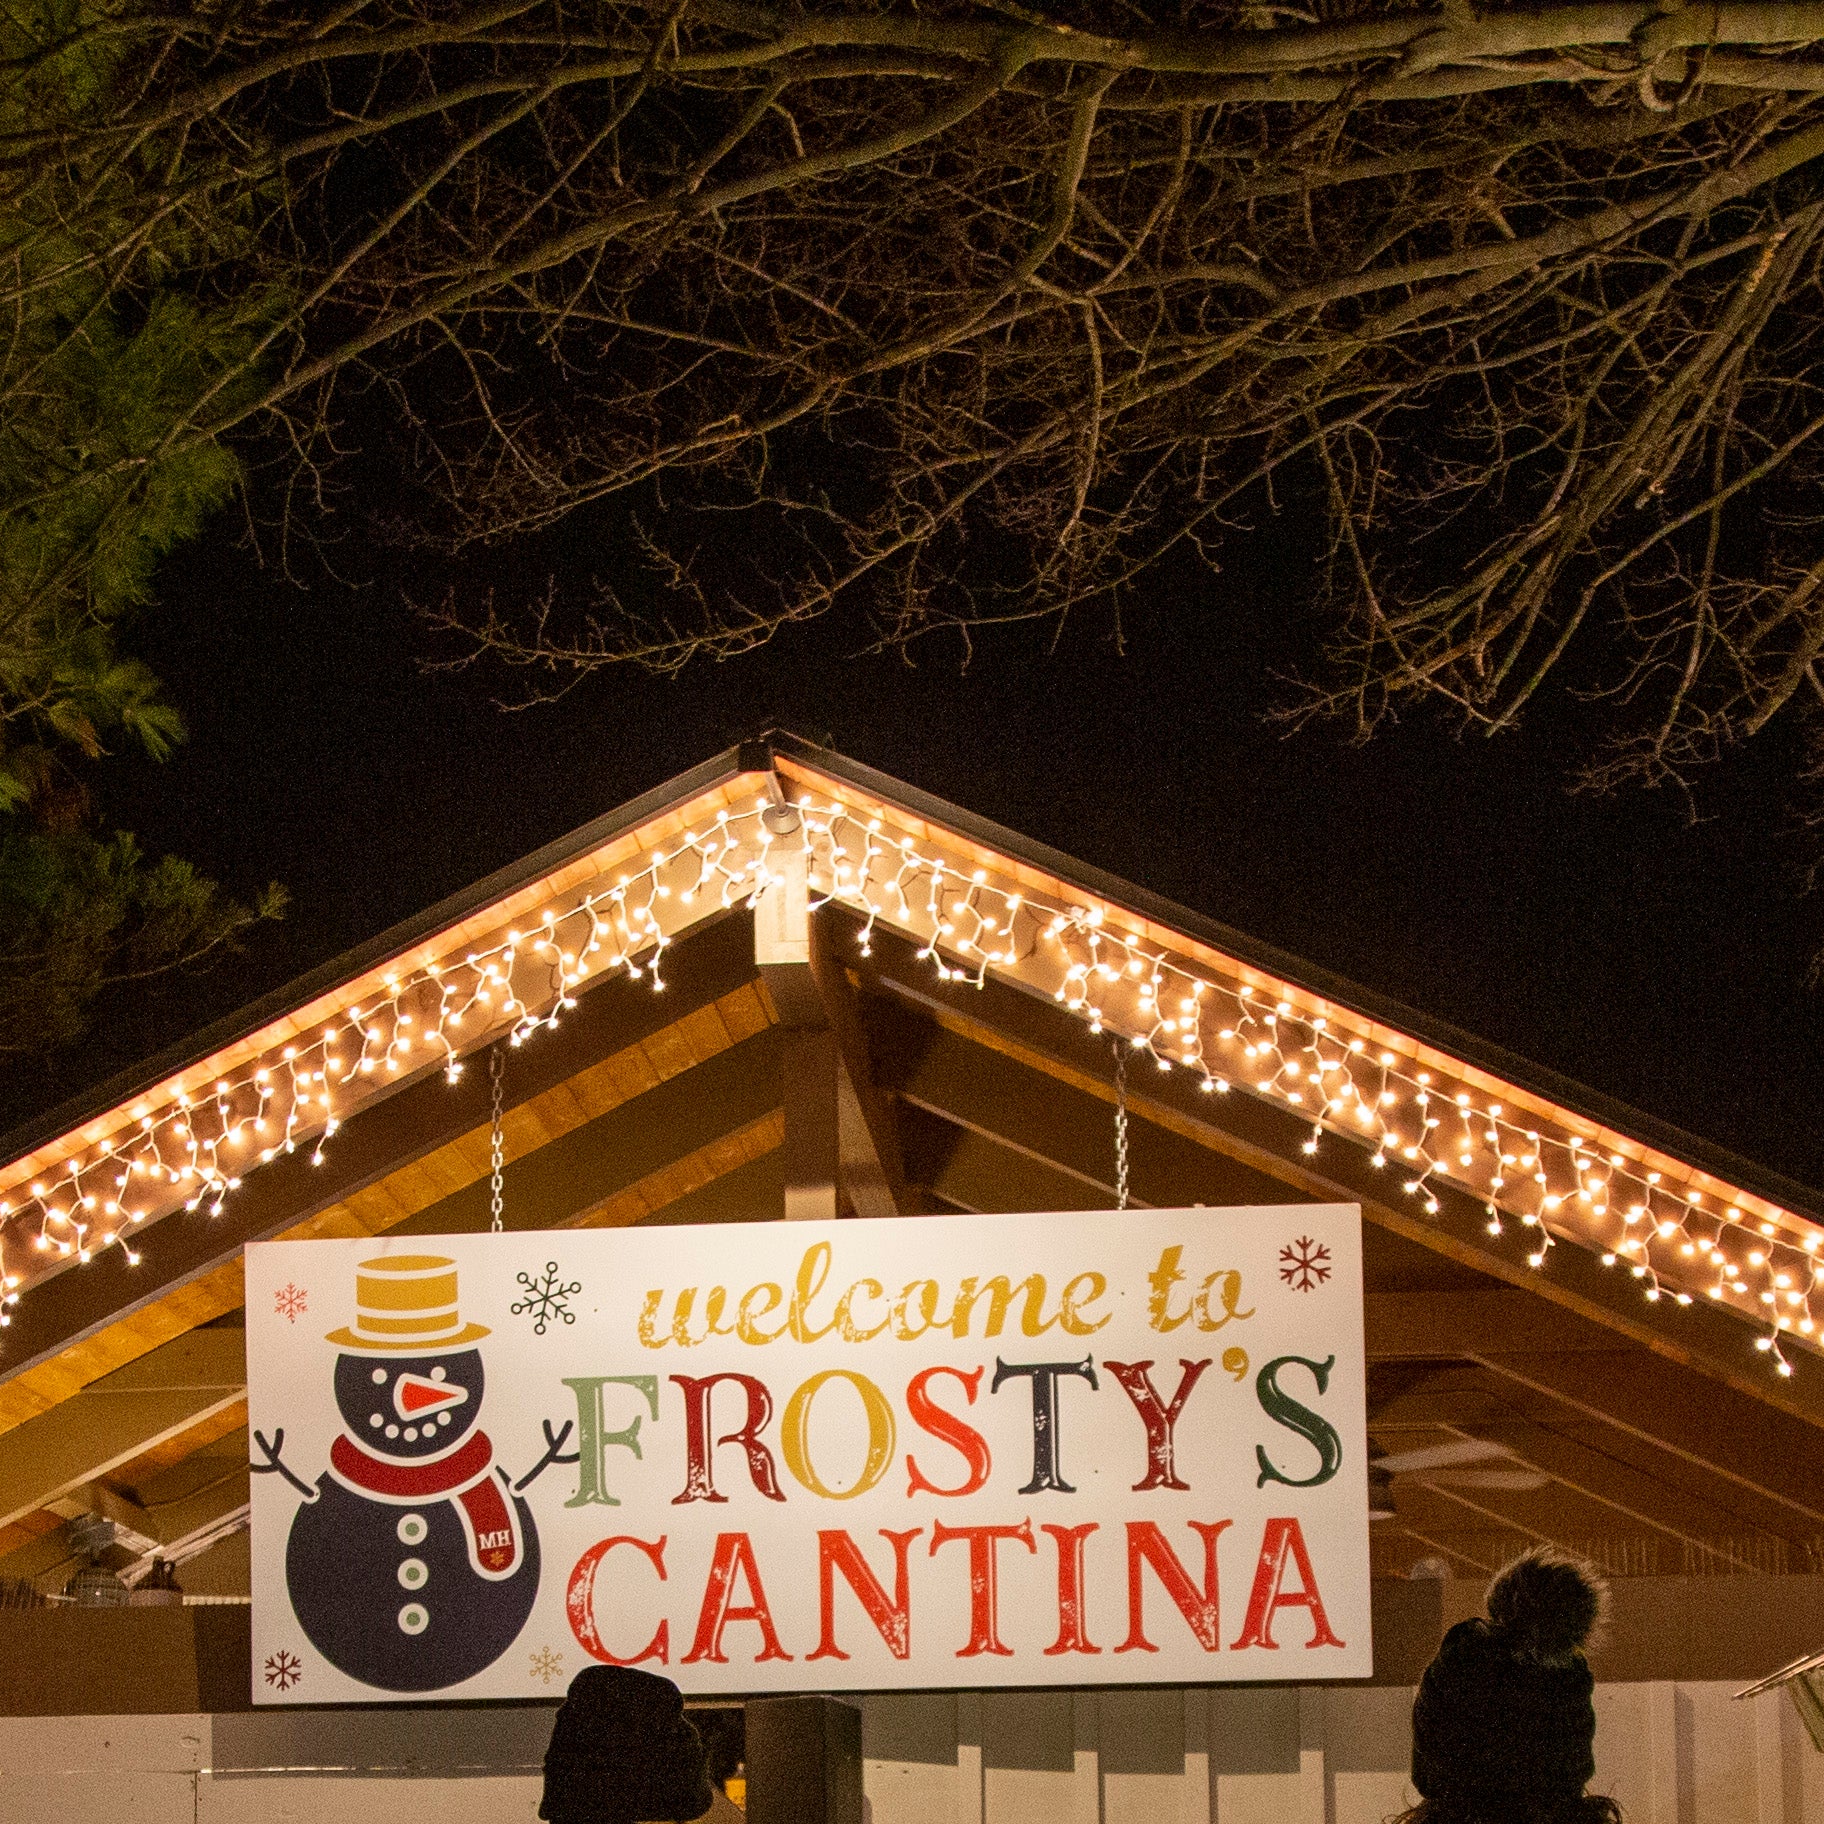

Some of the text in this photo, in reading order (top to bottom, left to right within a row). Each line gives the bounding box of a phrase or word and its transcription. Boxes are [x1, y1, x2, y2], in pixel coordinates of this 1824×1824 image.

[637, 1240, 1256, 1350] welcome to
[561, 1346, 1343, 1508] FROSTY'S
[478, 1529, 512, 1550] MH
[565, 1515, 1347, 1666] CANTINA
